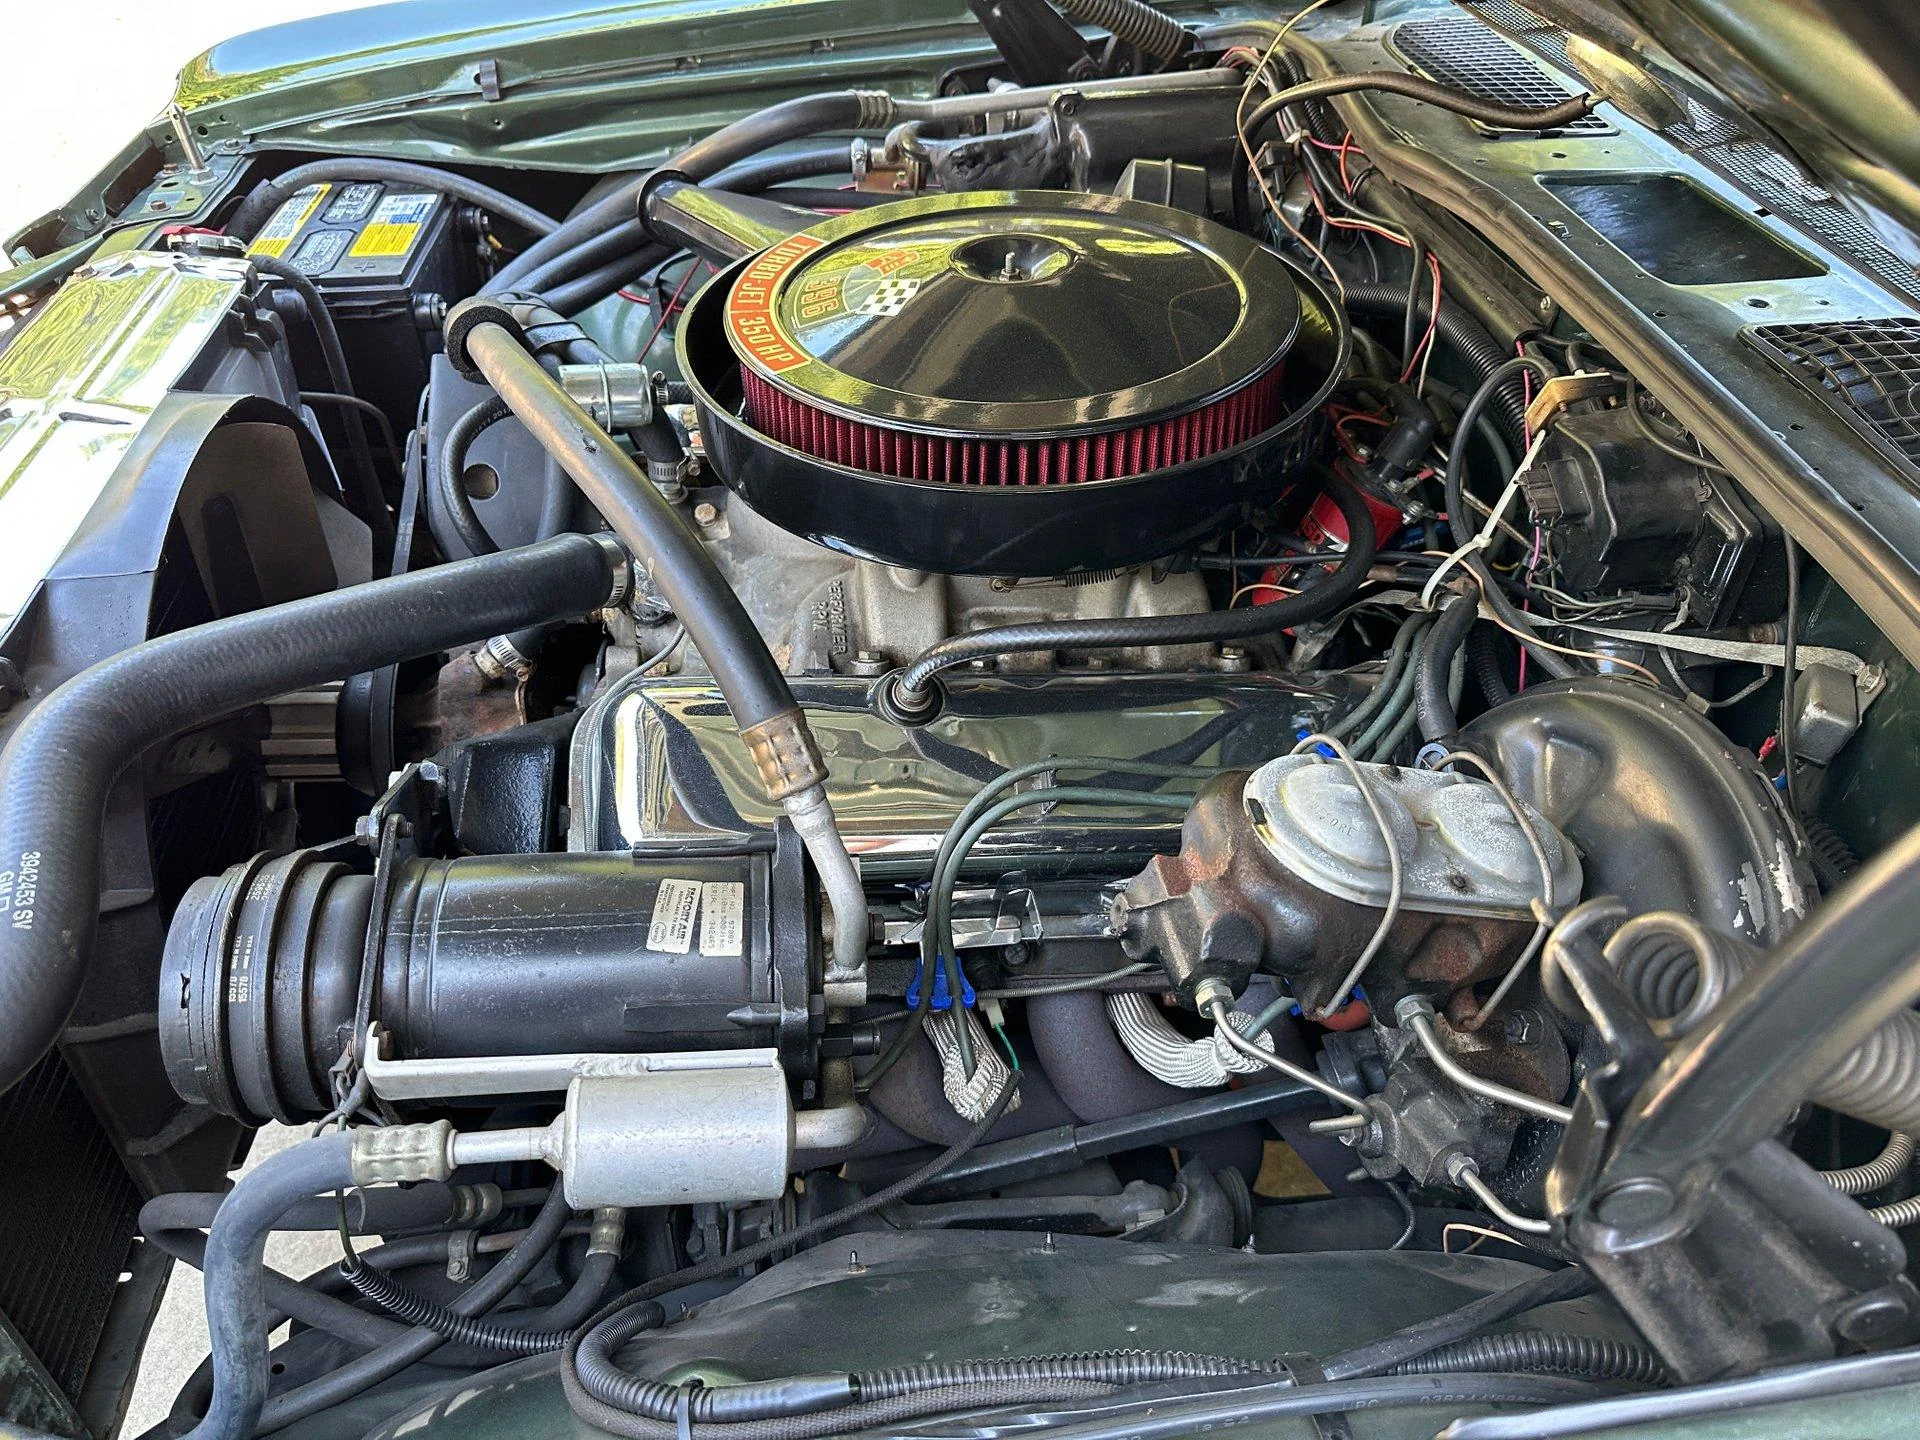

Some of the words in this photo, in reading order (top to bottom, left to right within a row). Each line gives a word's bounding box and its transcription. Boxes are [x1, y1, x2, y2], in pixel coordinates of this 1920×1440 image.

[737, 240, 812, 306] TURBO-JET
[801, 275, 843, 319] 396
[737, 315, 773, 349] 350
[754, 343, 796, 364] HP
[810, 601, 830, 632] RPM
[827, 579, 848, 656] PERFORMER
[14, 851, 41, 907] 3942453
[12, 909, 34, 930] SV
[679, 886, 697, 923] FACTORY
[238, 975, 249, 1003] 15570
